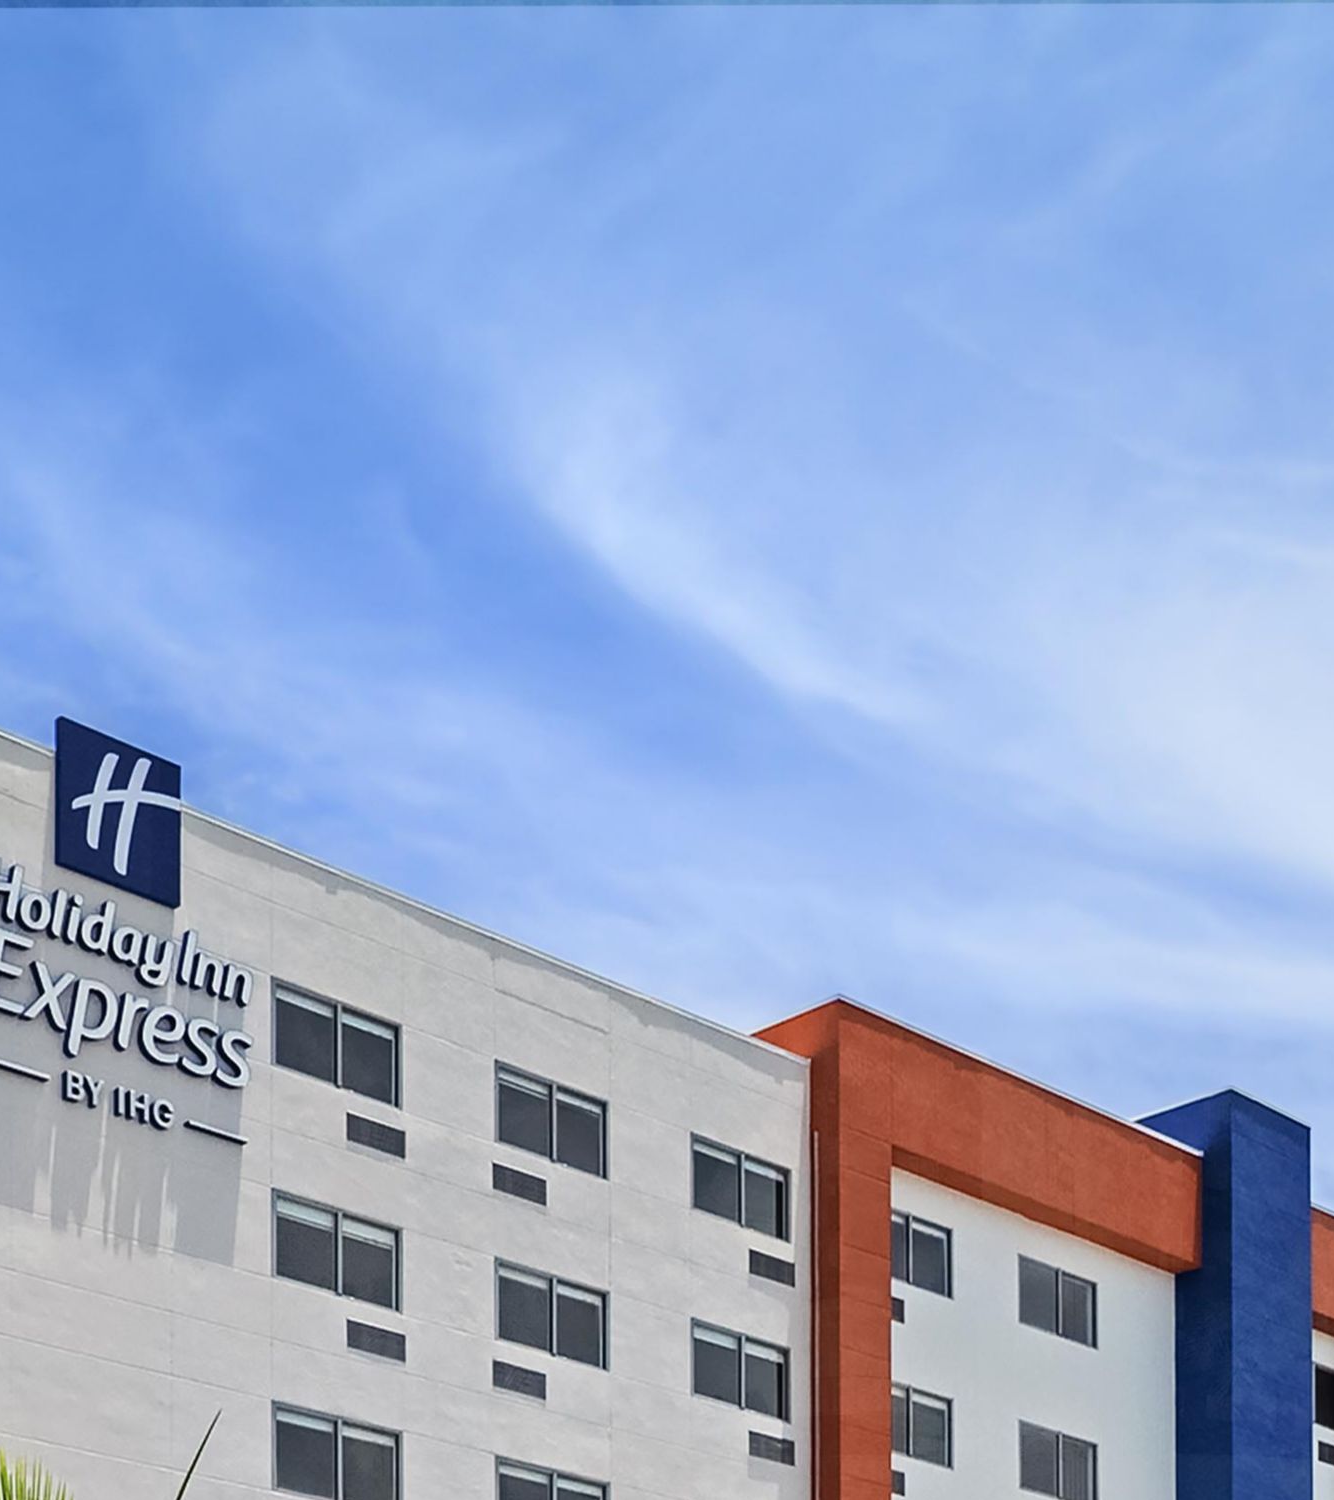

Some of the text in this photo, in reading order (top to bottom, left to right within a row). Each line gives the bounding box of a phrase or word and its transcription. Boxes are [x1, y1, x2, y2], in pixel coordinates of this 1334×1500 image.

[177, 930, 254, 1006] Inn
[62, 1070, 175, 1129] BY IHG
